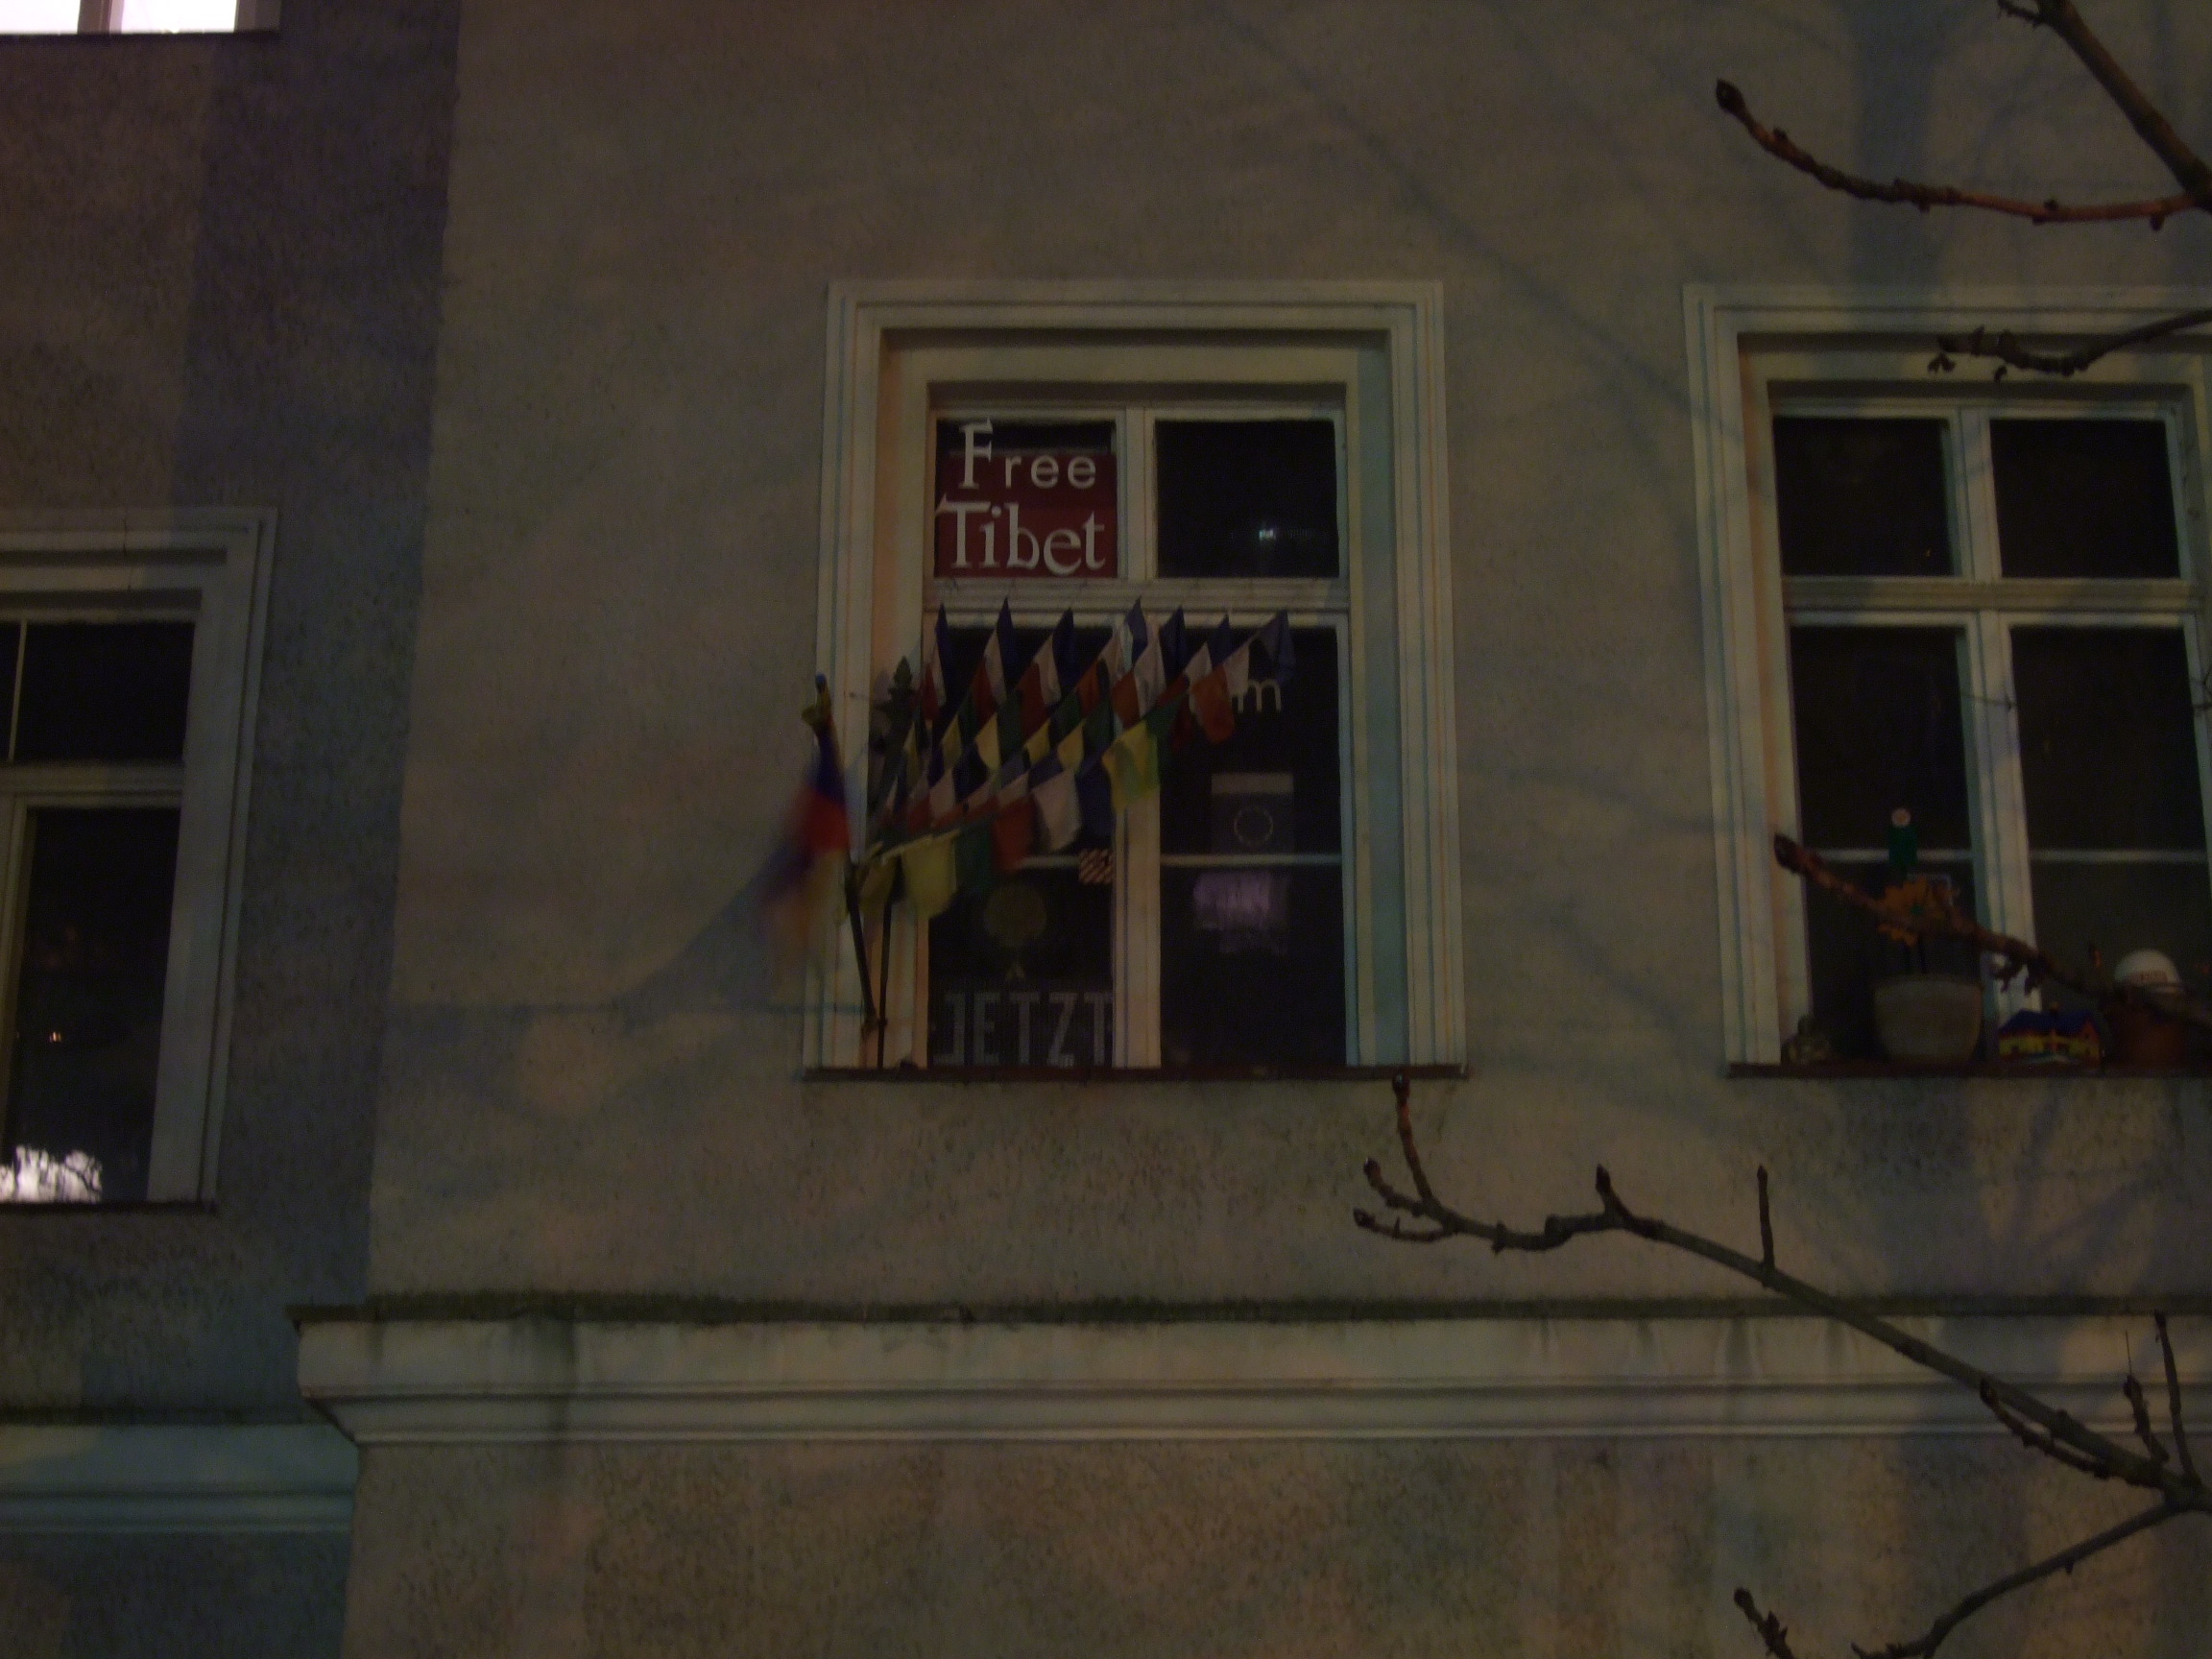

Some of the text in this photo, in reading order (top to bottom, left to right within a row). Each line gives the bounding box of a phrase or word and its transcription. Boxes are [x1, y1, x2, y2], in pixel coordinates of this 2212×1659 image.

[958, 417, 1096, 490] Free
[935, 493, 1106, 576] Tibet
[933, 991, 1114, 1067] JETZT
